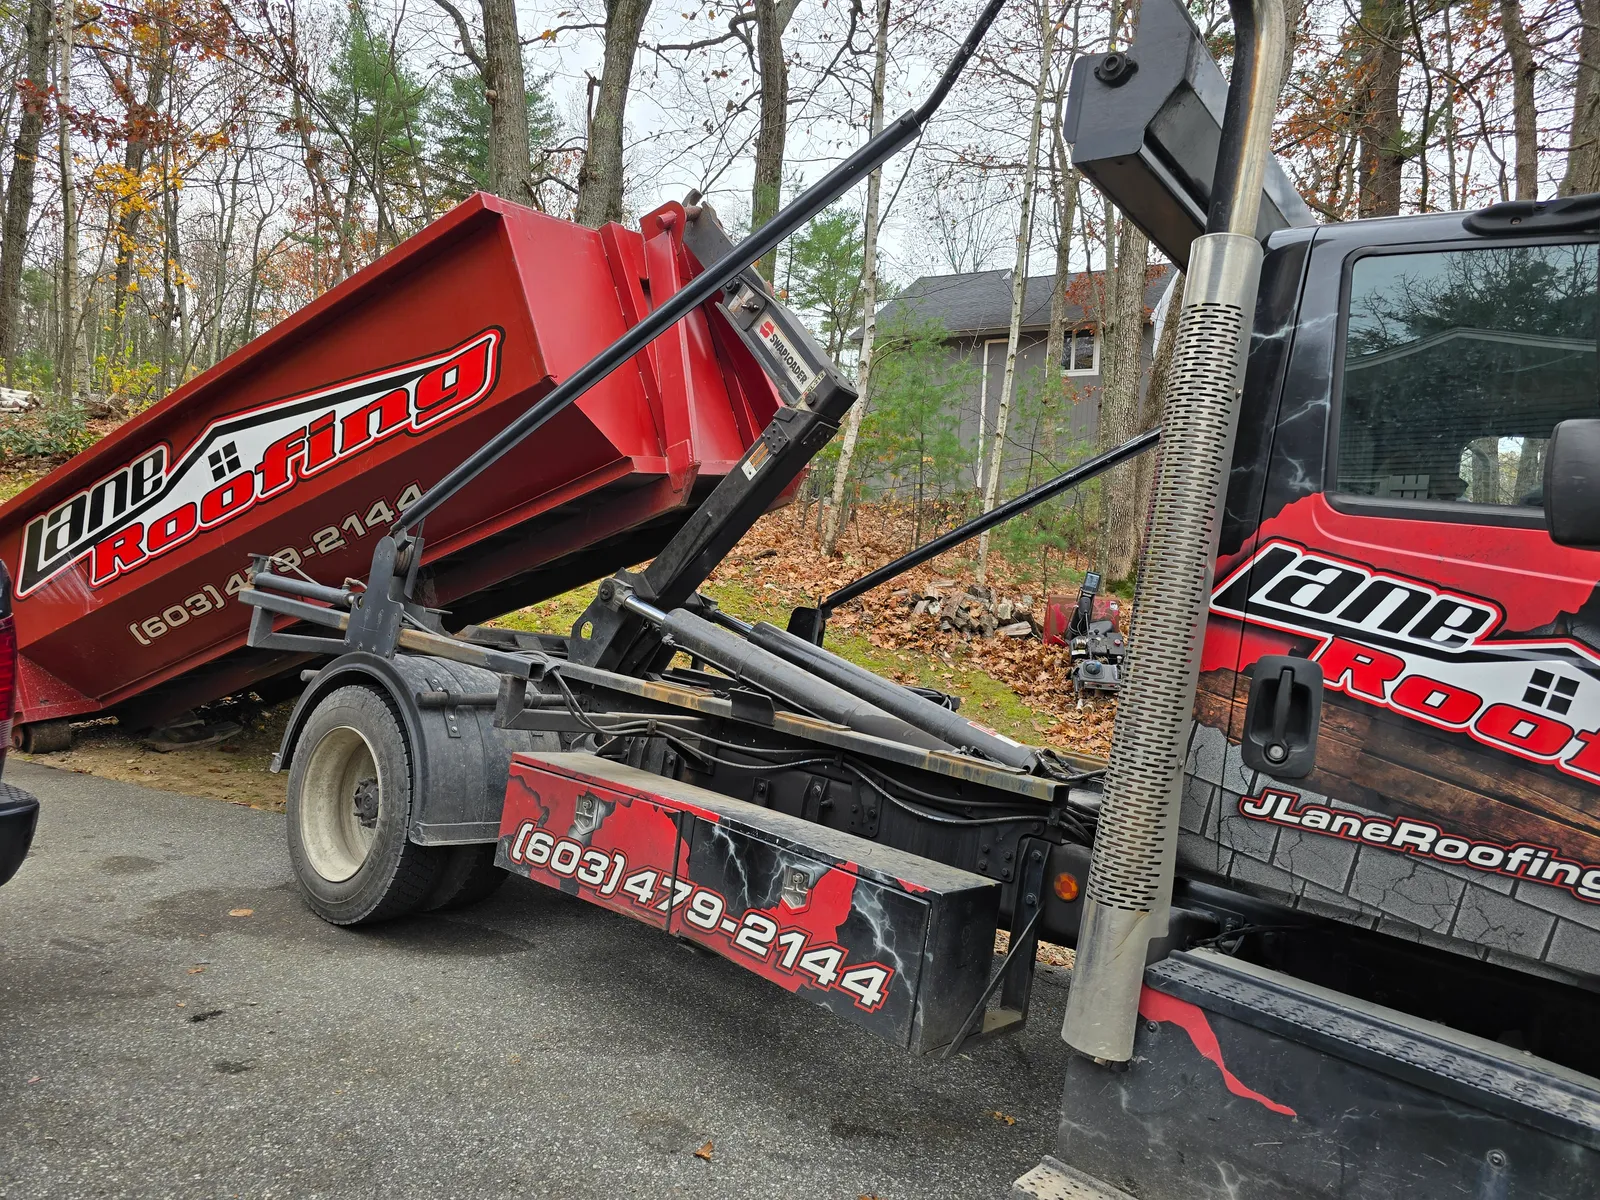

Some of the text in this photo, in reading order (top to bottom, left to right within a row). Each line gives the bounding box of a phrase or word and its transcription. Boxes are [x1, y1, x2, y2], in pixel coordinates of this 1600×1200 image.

[769, 333, 808, 385] SWAPLOADER
[94, 336, 492, 582] Roofing
[511, 822, 889, 1007] (603)479-2144
